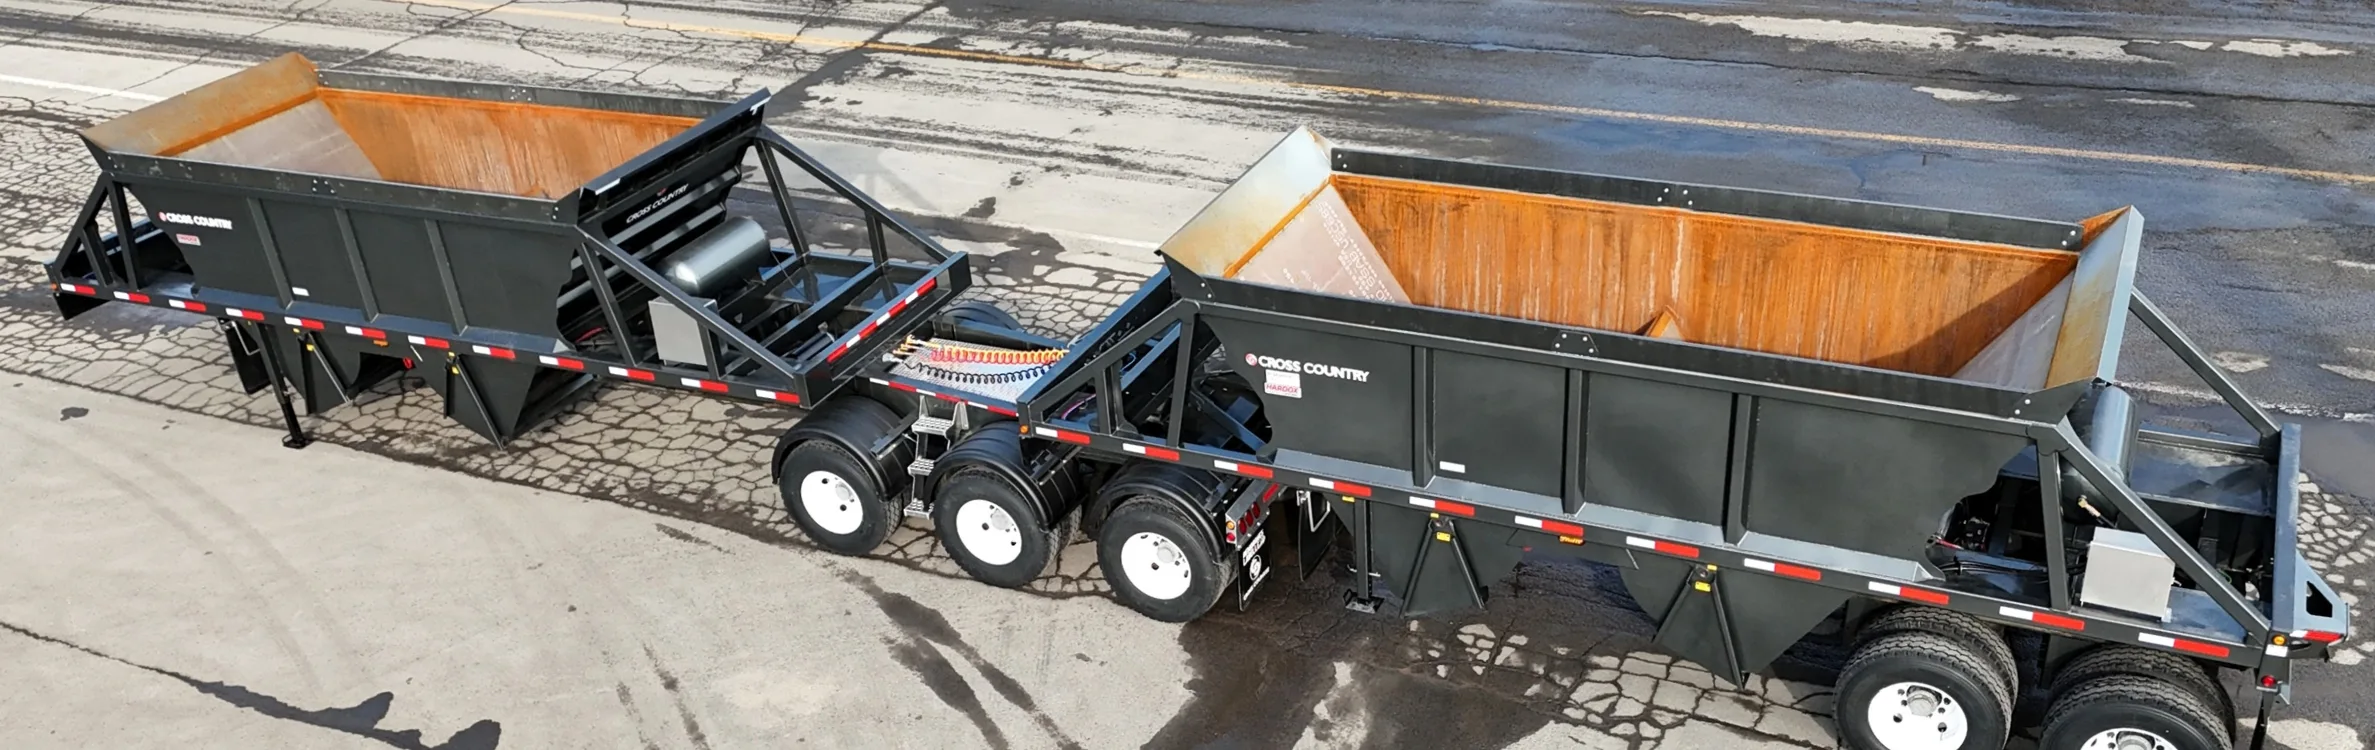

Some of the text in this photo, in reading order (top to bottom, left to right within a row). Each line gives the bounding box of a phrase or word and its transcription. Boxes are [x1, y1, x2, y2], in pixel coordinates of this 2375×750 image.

[652, 183, 689, 209] COUNTRY
[1258, 355, 1370, 383] CROSS COUNTRY
[1266, 383, 1299, 394] HARDOX
